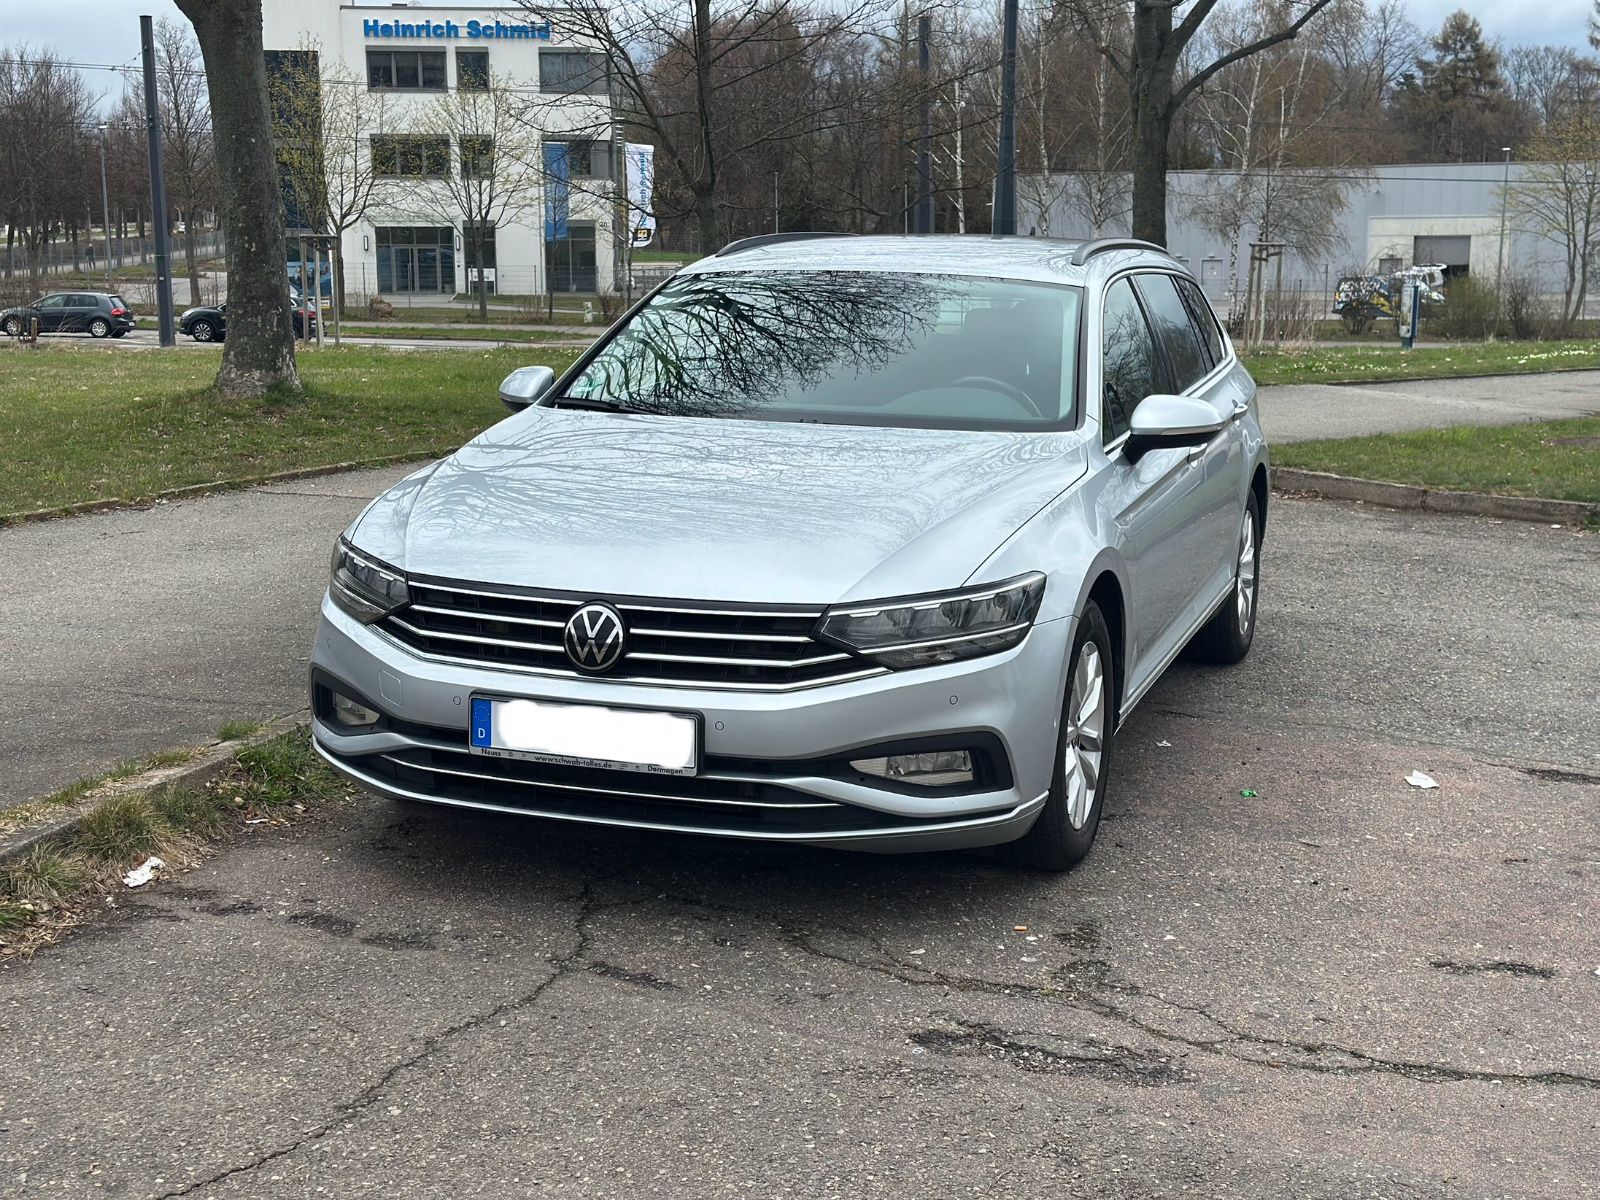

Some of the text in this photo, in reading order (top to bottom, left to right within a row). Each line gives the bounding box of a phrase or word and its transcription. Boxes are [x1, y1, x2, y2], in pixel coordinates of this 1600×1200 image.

[363, 19, 550, 39] Heinrich Schmid
[478, 727, 486, 739] D
[481, 748, 502, 757] Neuss
[647, 765, 684, 775] Dormagen
